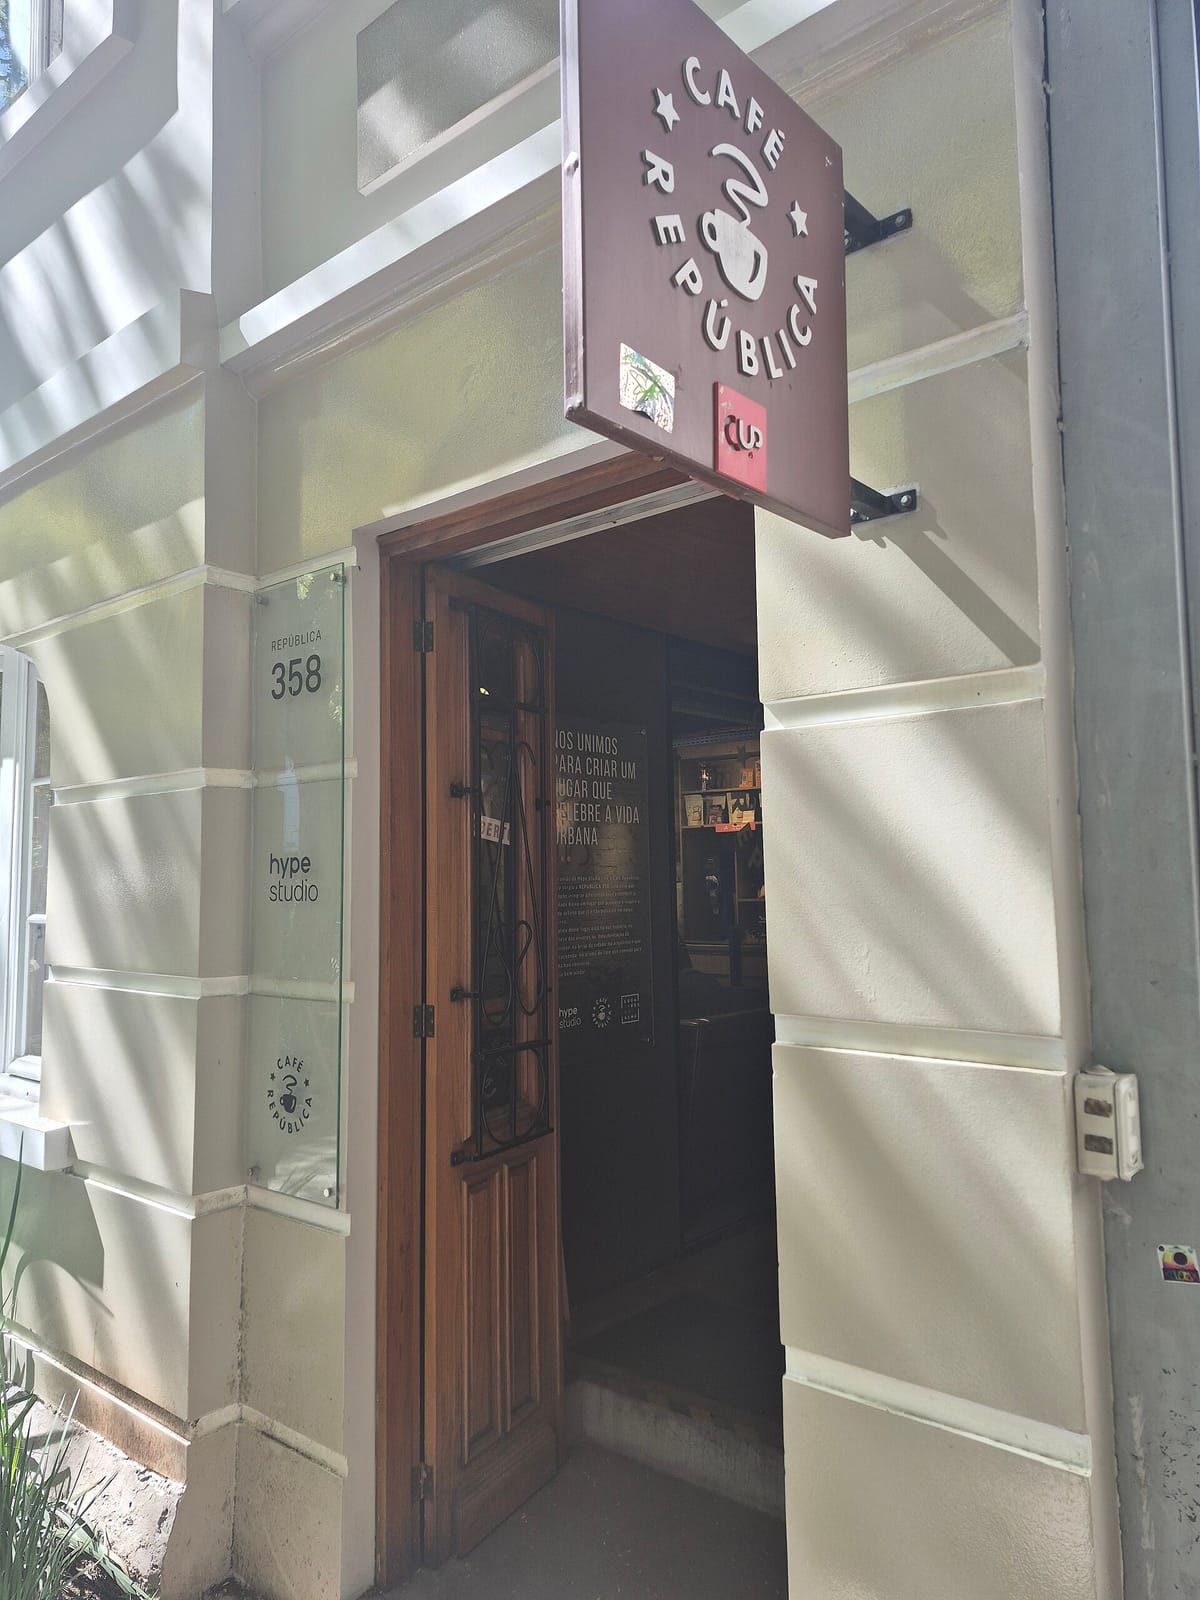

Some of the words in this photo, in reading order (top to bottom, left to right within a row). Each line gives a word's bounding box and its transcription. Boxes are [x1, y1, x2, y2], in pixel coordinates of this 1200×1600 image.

[682, 56, 786, 171] CAFÉ
[642, 149, 818, 380] REPÚBLICA
[271, 629, 322, 652] REPÚBLICA
[271, 654, 322, 700] 358
[577, 732, 618, 755] UNIMOS
[556, 754, 582, 774] ARA
[586, 757, 618, 778] CRIAR
[621, 761, 637, 780] UM
[556, 778, 588, 798] UGAR
[592, 781, 613, 800] QUE
[556, 802, 601, 822] ELEBRE
[605, 805, 612, 823] A
[615, 805, 640, 824] VIDA
[269, 852, 311, 879] hype
[269, 878, 319, 902] studio
[558, 1007, 578, 1019] hype
[559, 1017, 582, 1029] studio
[277, 1055, 304, 1073] CAFÉ
[267, 1089, 313, 1134] REPÚBLICA
